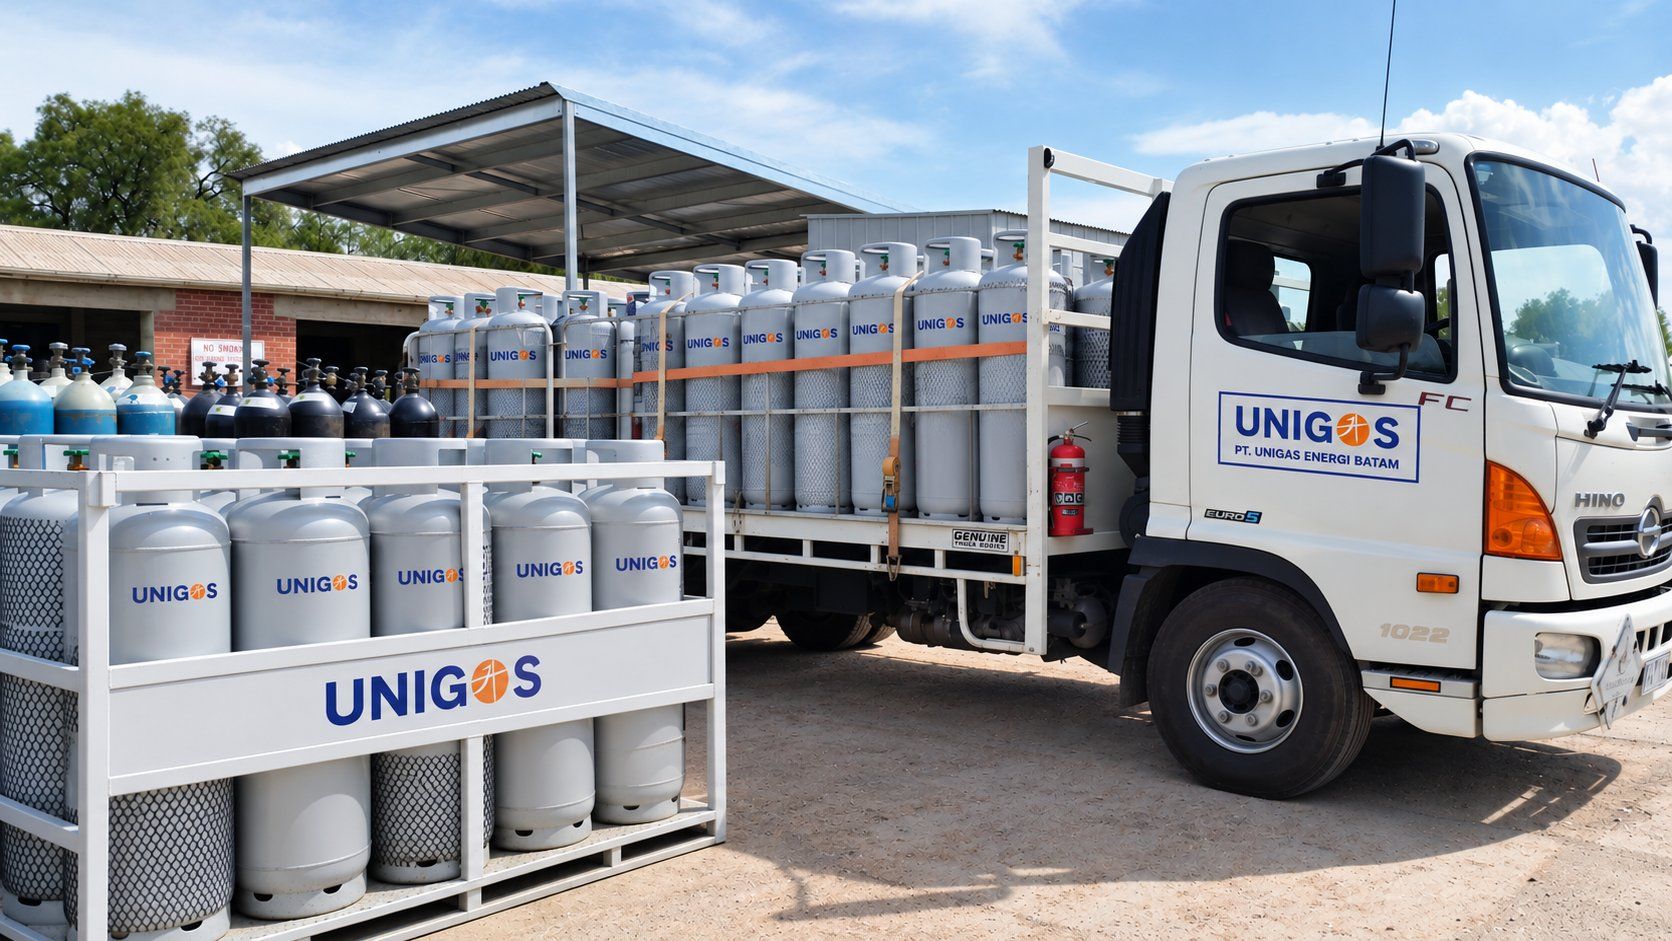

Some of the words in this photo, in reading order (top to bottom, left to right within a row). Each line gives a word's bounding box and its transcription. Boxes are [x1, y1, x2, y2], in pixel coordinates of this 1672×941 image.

[203, 344, 214, 352] NO
[1418, 391, 1472, 412] FC
[1235, 444, 1251, 456] PT.
[1255, 447, 1300, 460] UNIGAS
[1304, 451, 1350, 465] ENERGI
[1354, 455, 1399, 470] BATAM
[1574, 492, 1625, 508] HINO
[954, 531, 1007, 544] GENUINE
[1380, 623, 1450, 644] 1022
